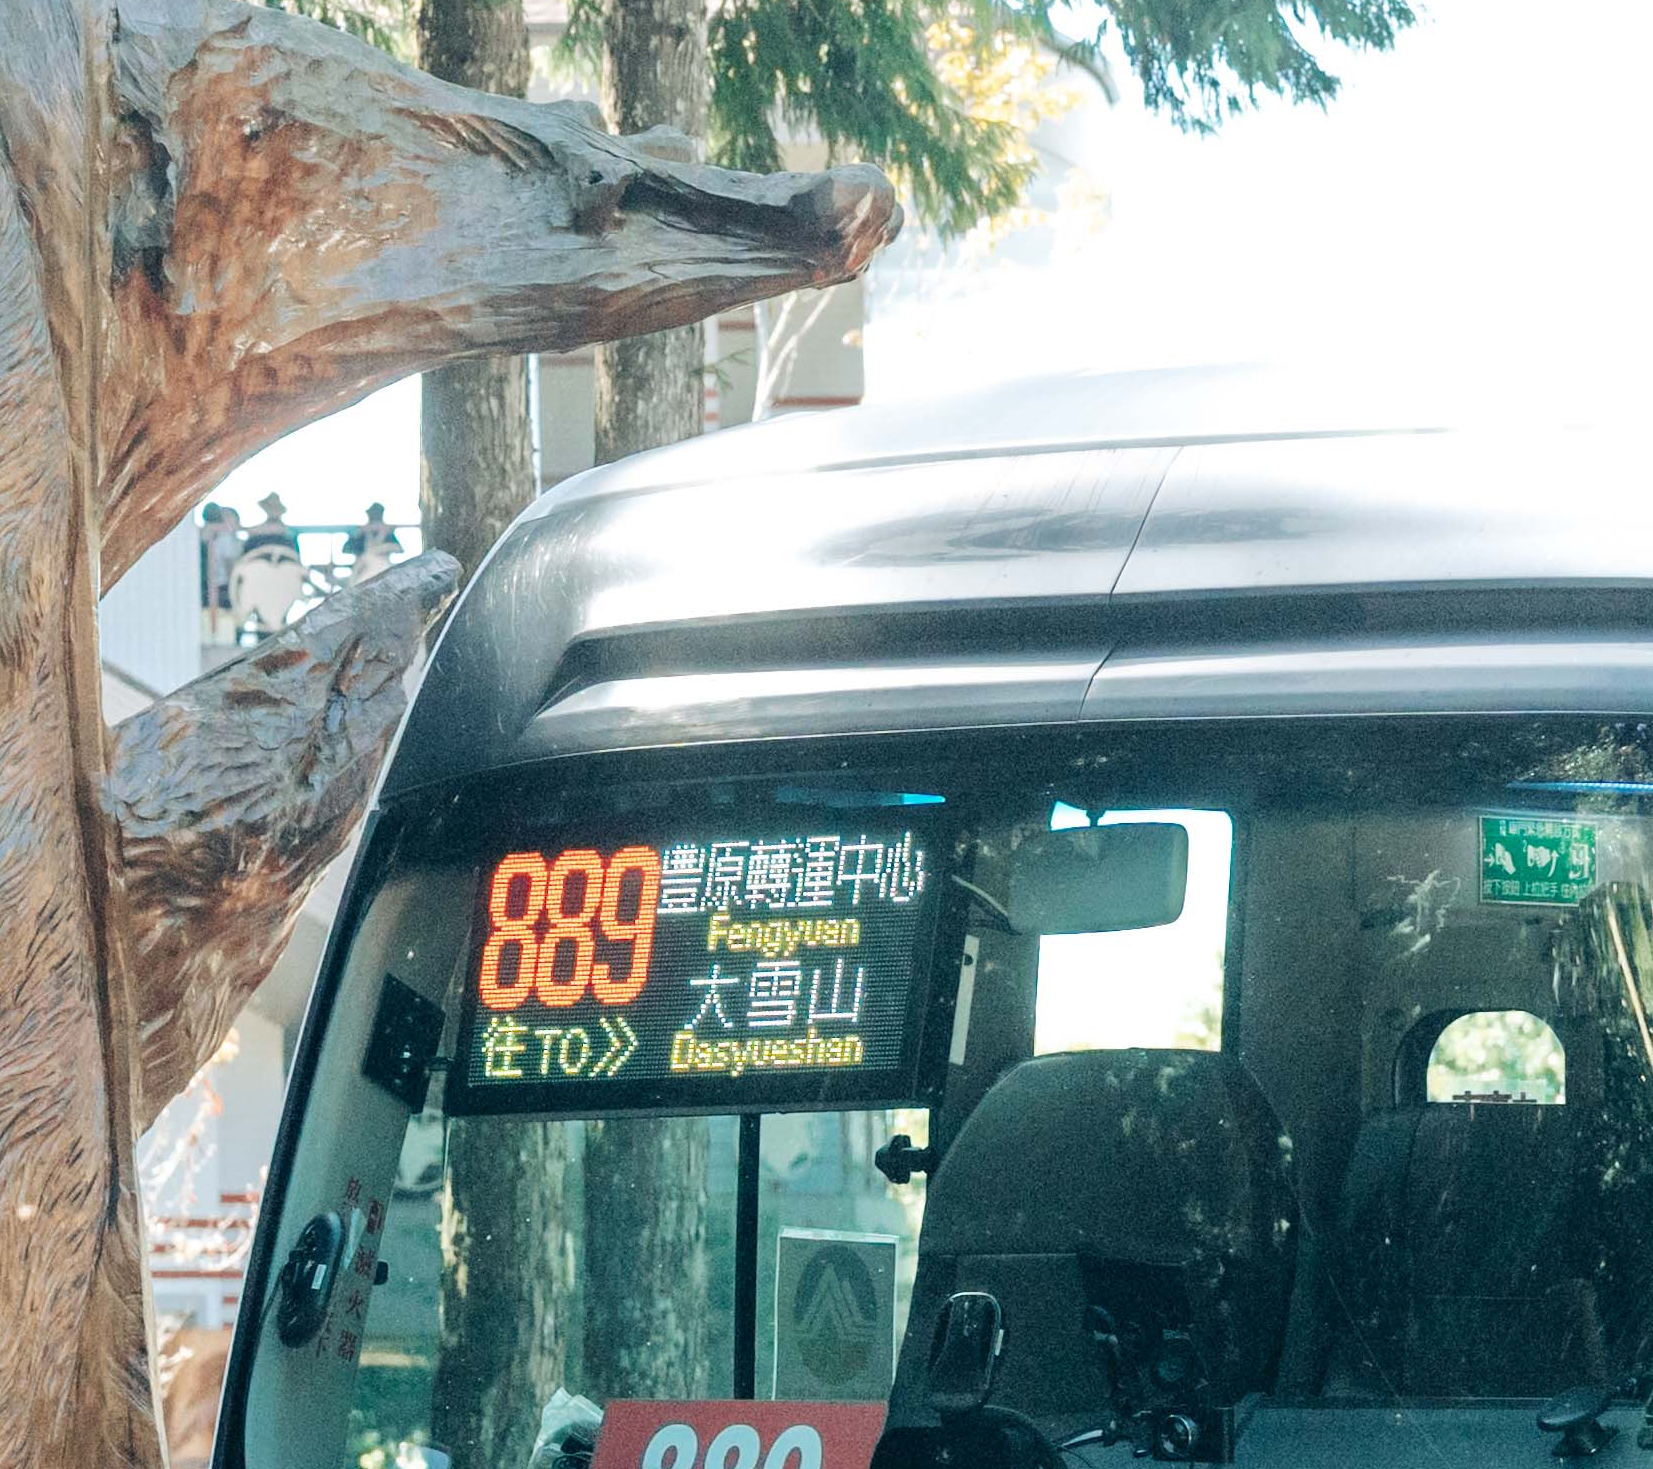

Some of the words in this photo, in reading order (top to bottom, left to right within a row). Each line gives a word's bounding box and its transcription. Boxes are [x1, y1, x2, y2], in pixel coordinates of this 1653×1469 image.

[657, 830, 926, 915] 豐原轉運中心
[478, 844, 662, 1011] 889
[708, 913, 861, 960] Fengyuan
[683, 958, 866, 1031] 大雪山
[670, 1029, 865, 1078] Dasyueshan
